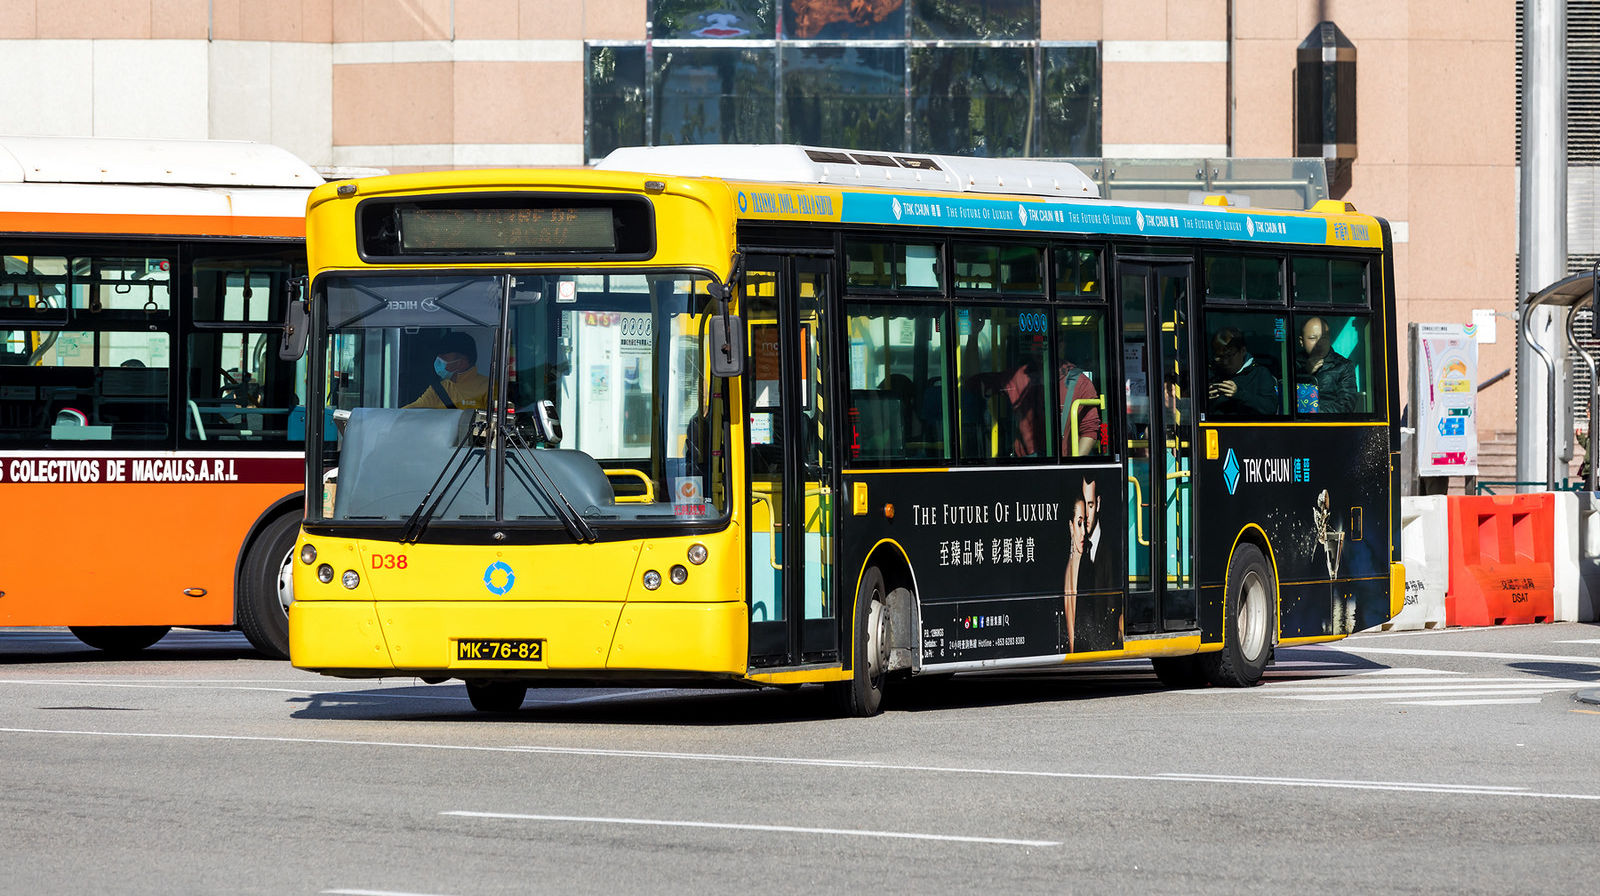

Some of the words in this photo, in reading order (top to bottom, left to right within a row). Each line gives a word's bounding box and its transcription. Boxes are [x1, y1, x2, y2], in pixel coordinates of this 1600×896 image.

[10, 460, 100, 482] COLECTIVOS
[106, 460, 125, 482] DE
[1243, 458, 1263, 483] TAK
[1264, 458, 1290, 483] CHUN
[371, 554, 408, 570] D38
[940, 538, 984, 566] 至臻品味
[991, 536, 1035, 564] 彰顯尊貴
[460, 642, 539, 658] MK-76-82
